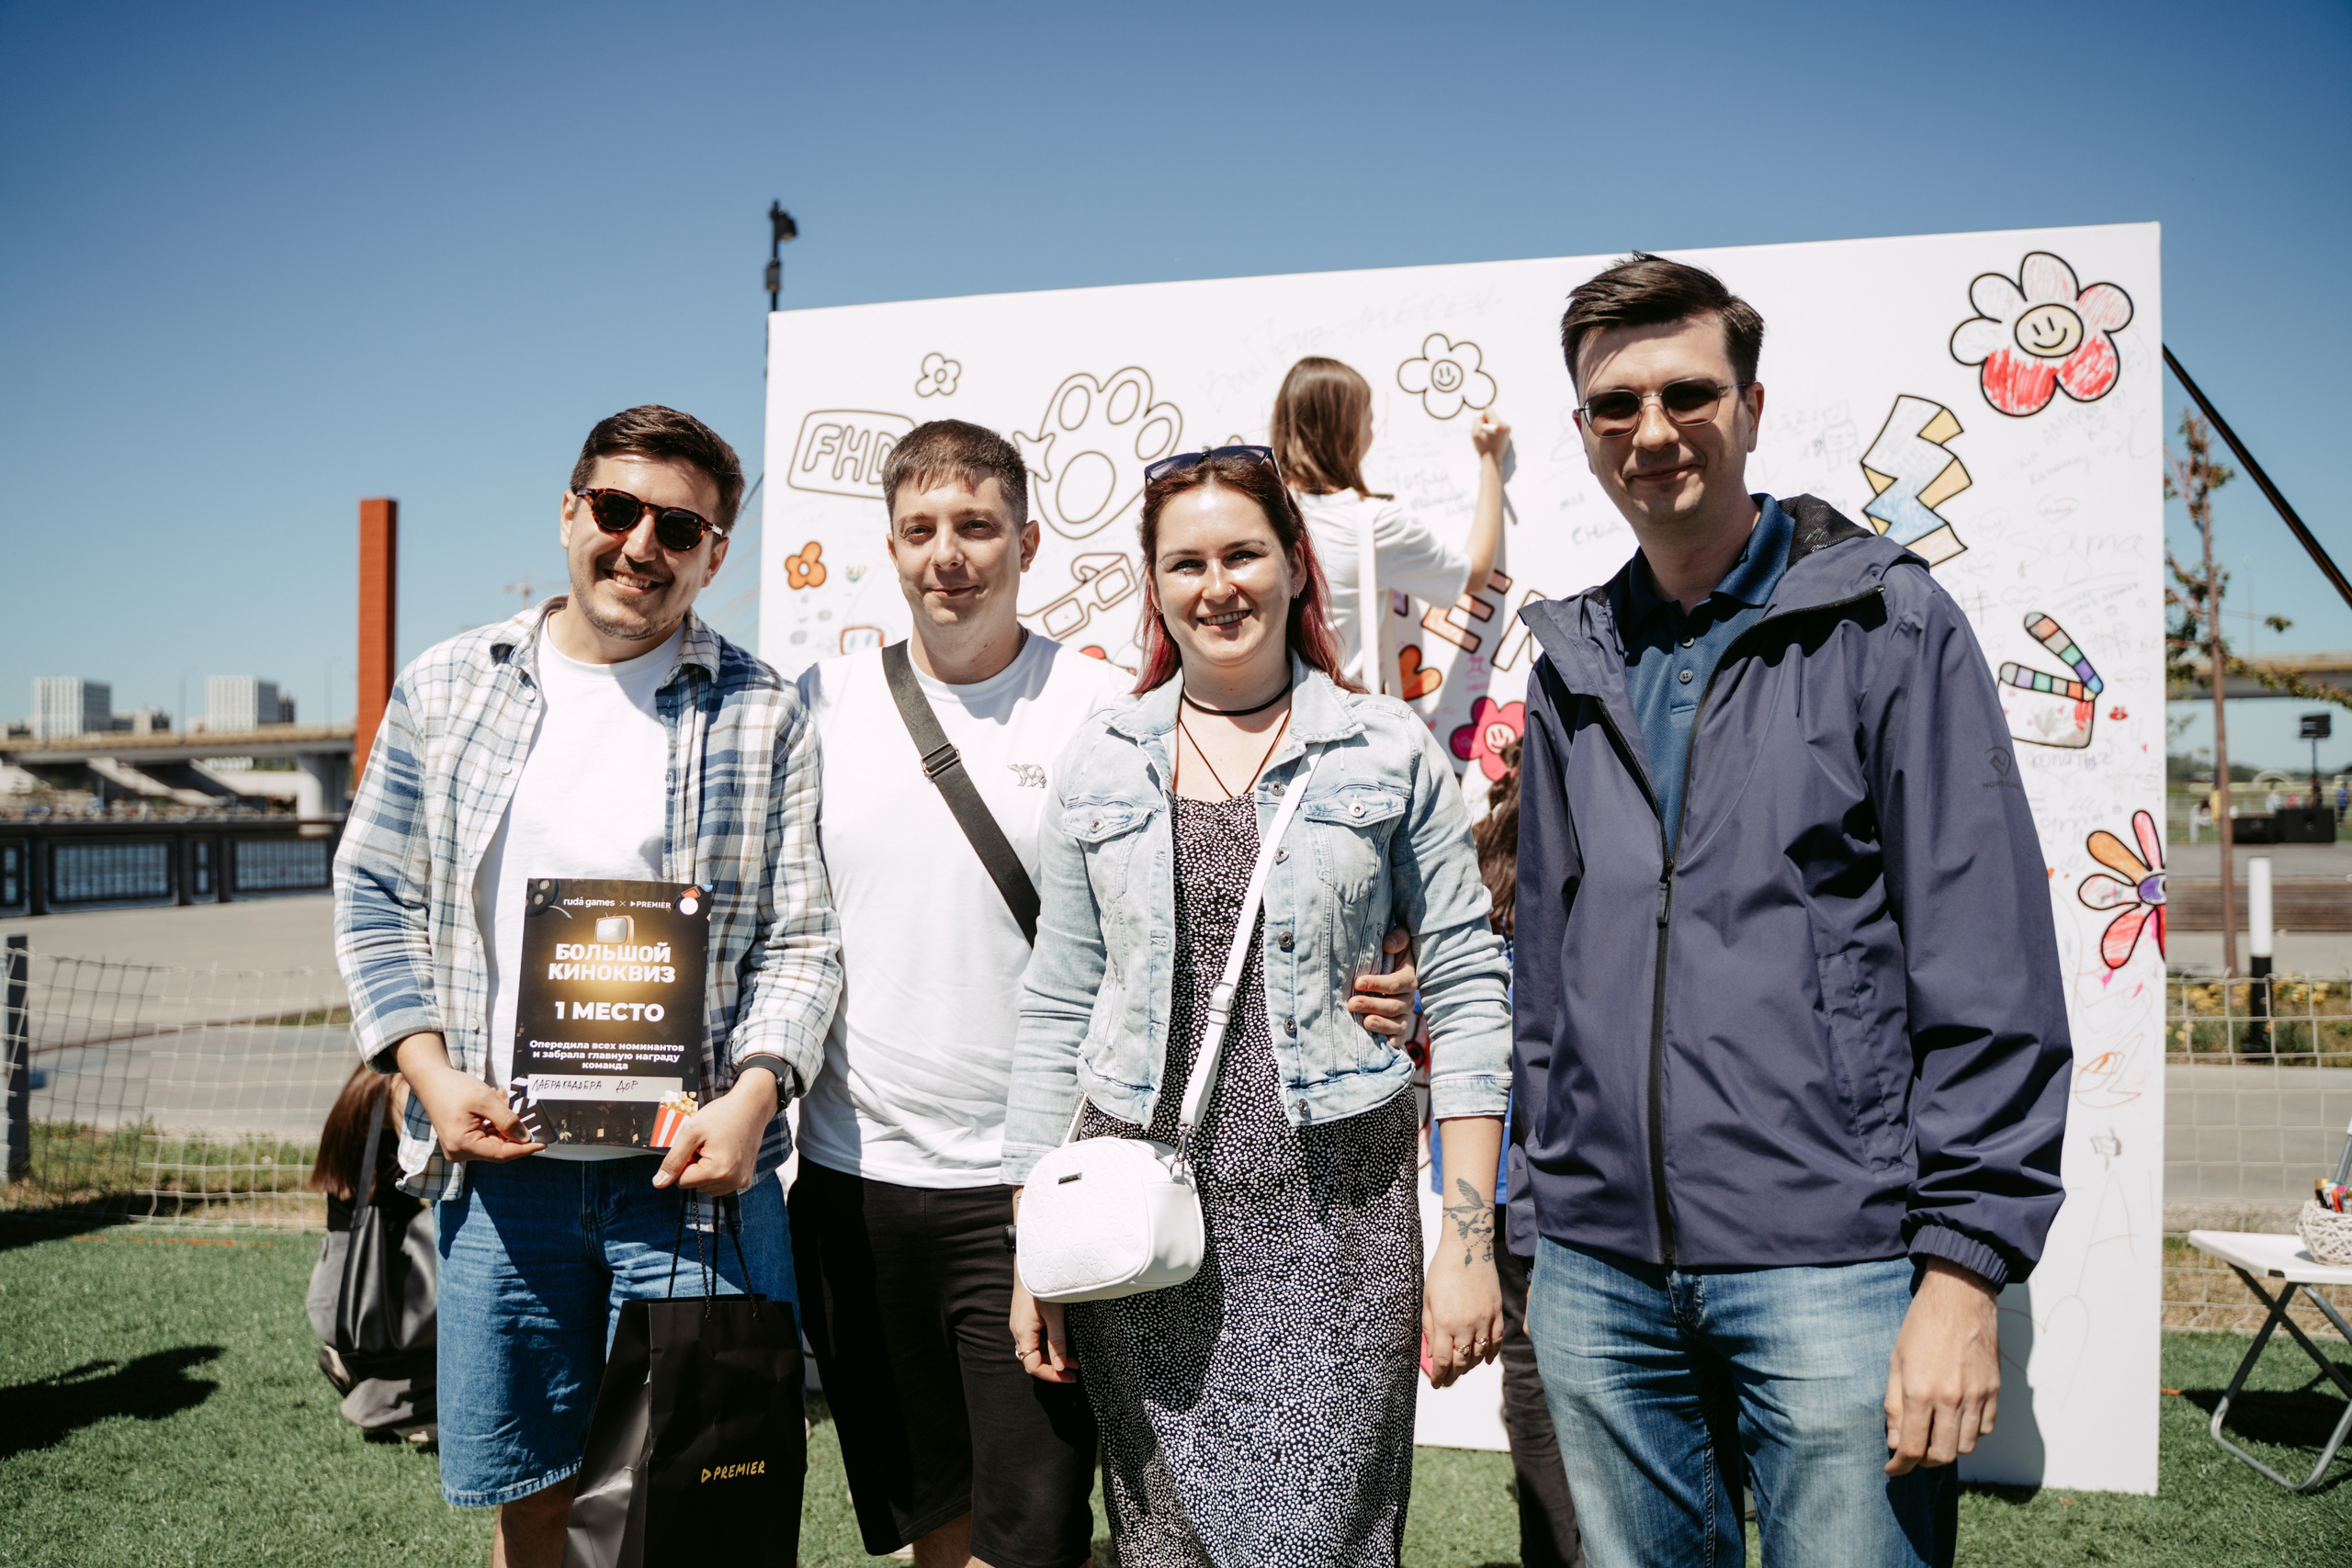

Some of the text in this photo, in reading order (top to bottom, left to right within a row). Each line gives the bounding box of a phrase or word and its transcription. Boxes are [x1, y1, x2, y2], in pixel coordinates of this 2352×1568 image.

[585, 899, 616, 908] games
[636, 901, 672, 909] PREMIER
[555, 942, 672, 964] БОЛЬШОЙ
[548, 963, 676, 983] КИНОКВИЗ
[555, 1001, 665, 1022] 1 МЕСТО
[529, 1040, 589, 1051] Опередила
[618, 1043, 685, 1052] номинантов
[542, 1050, 585, 1060] забрала
[588, 1053, 633, 1061] главную
[636, 1054, 680, 1063] награду
[582, 1062, 628, 1070] команда
[713, 1460, 765, 1481] PREMIER
